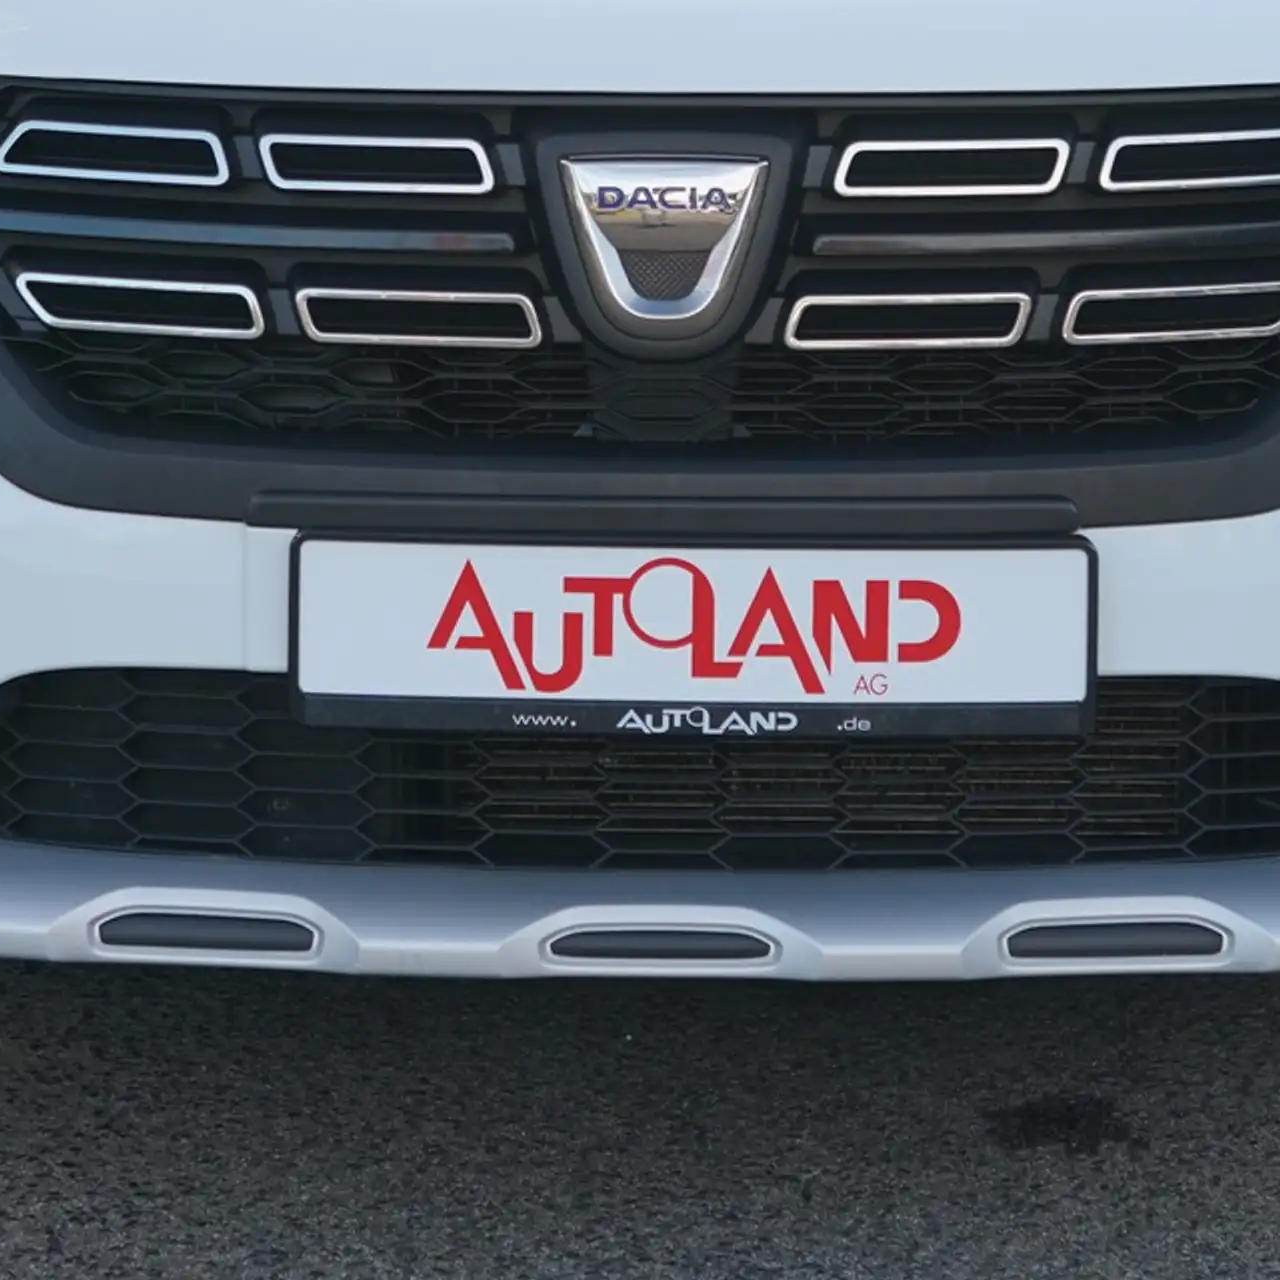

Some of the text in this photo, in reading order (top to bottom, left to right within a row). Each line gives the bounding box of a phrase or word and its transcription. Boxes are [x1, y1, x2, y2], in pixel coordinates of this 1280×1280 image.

[597, 186, 732, 210] DACIA
[426, 557, 962, 695] AUTOLAND
[853, 673, 889, 696] AG
[512, 706, 872, 735] www. AUTOLAND .de
